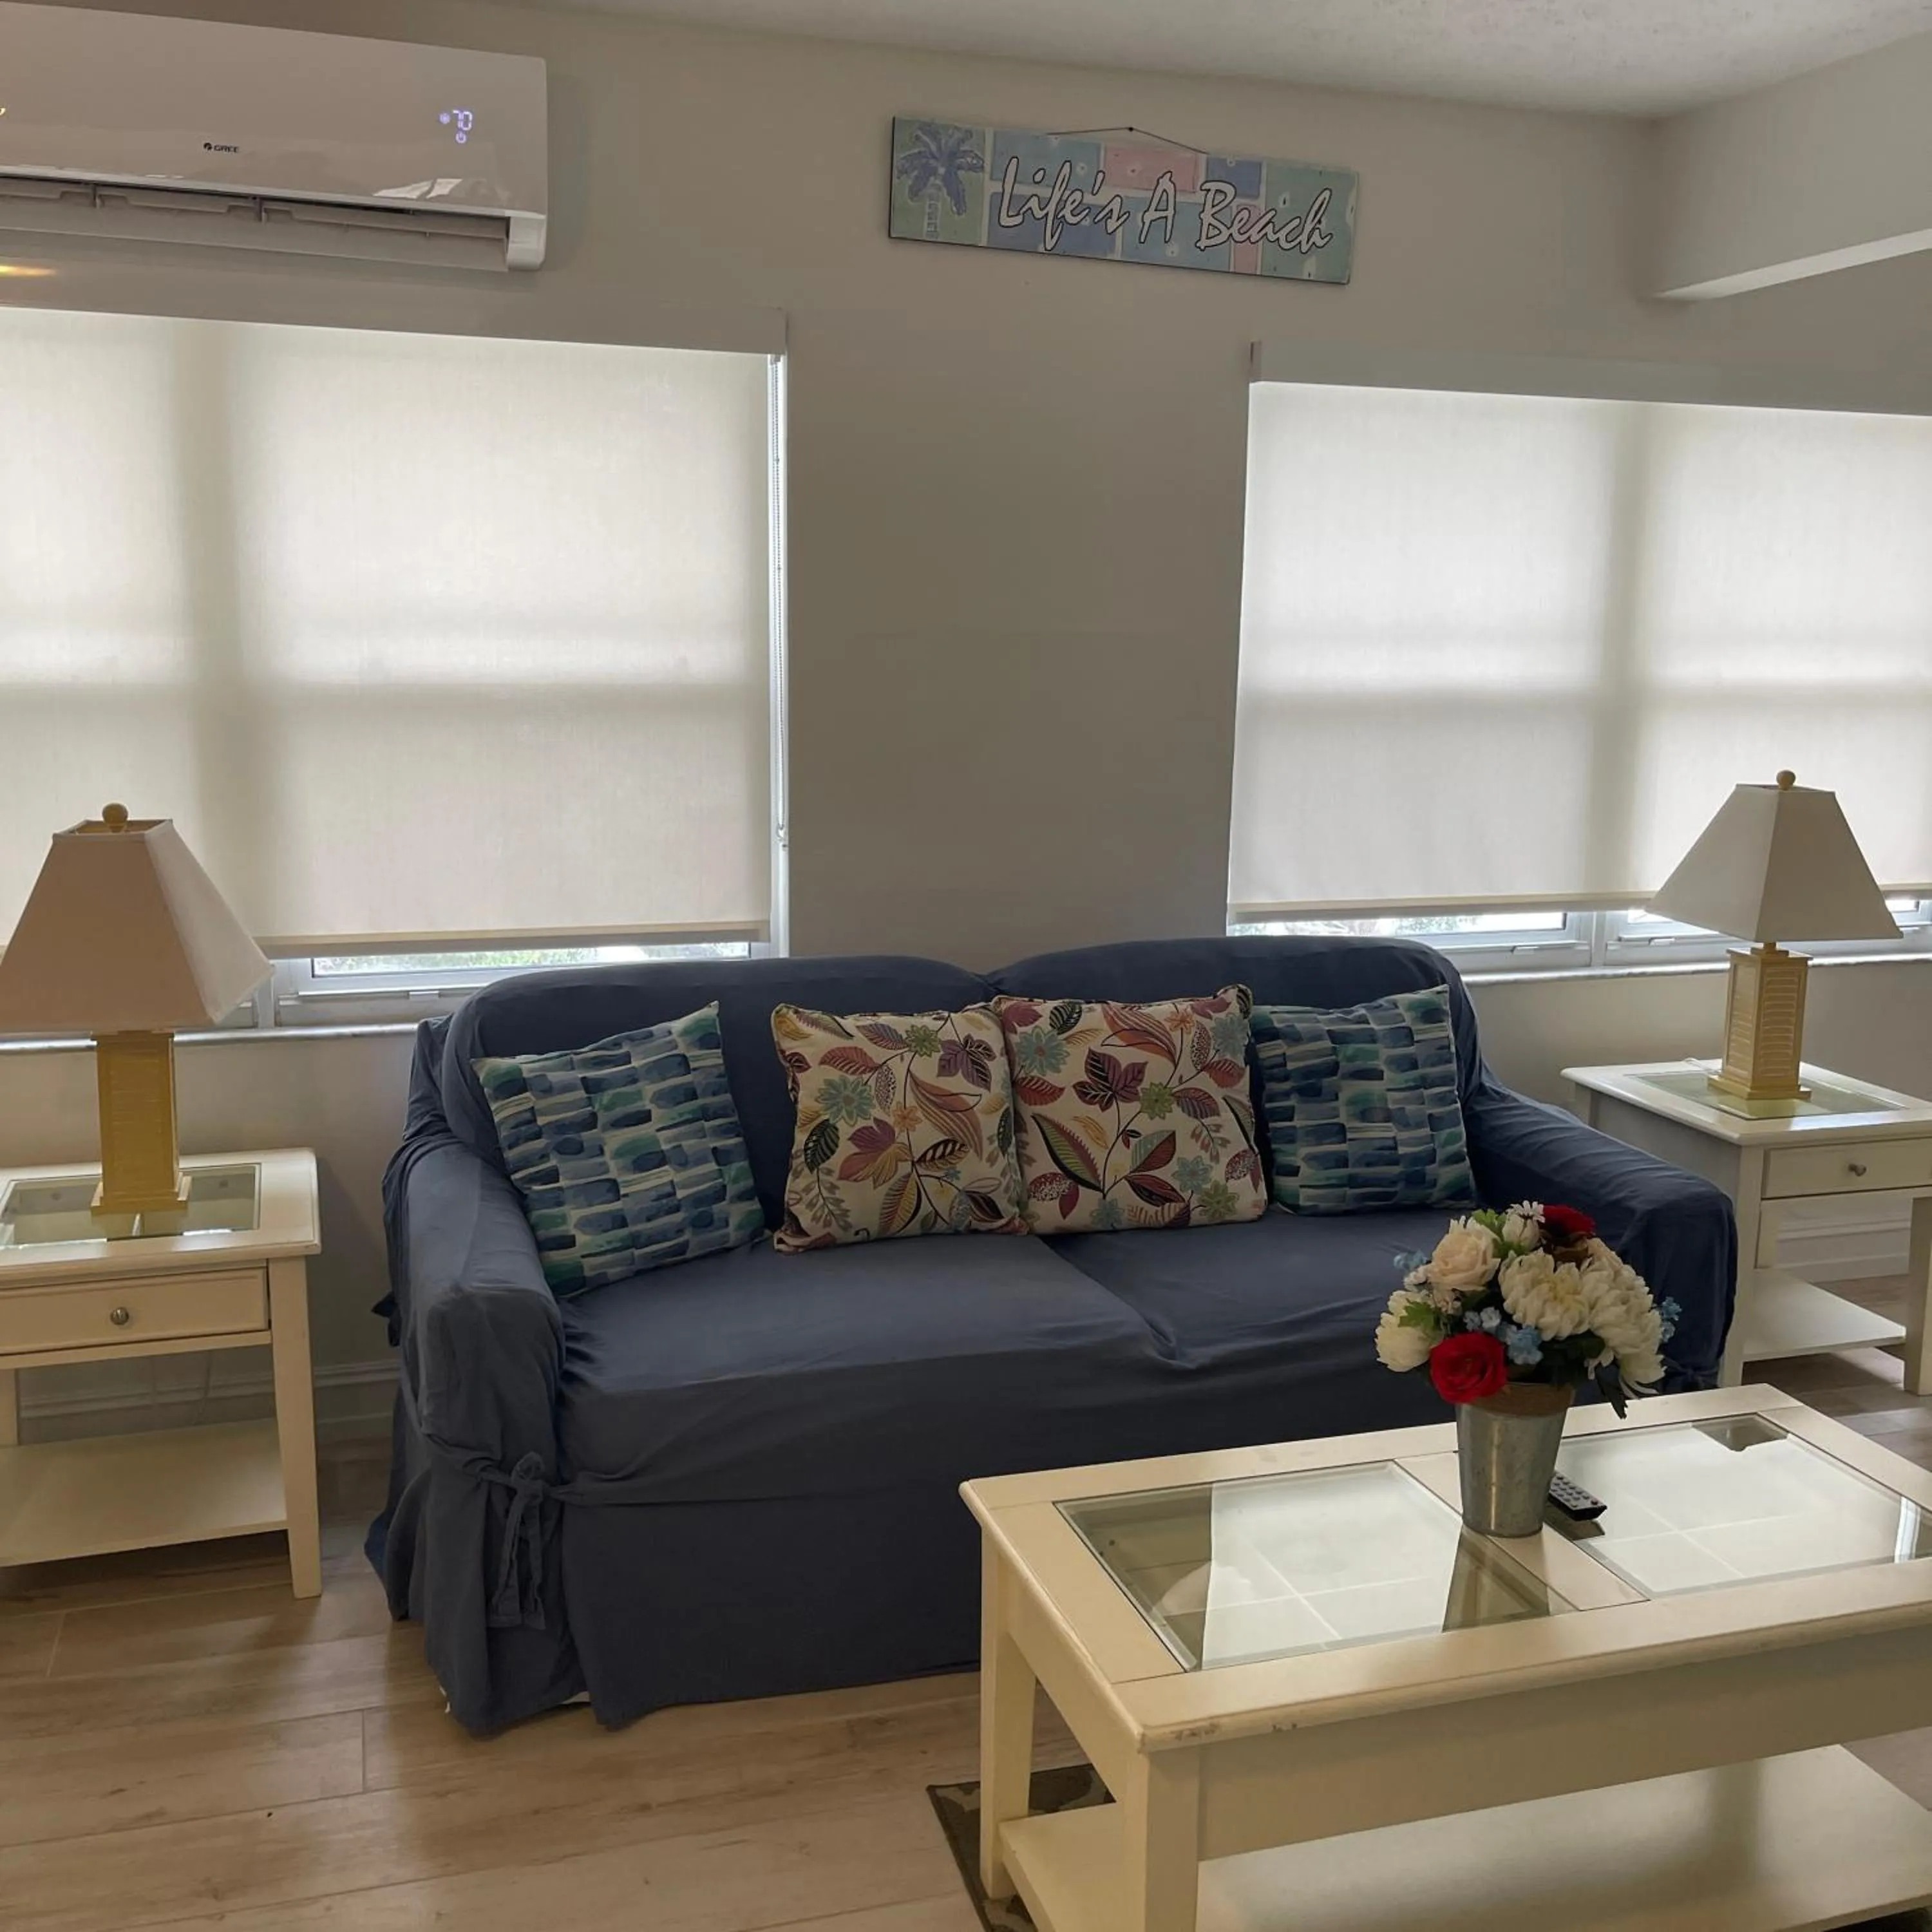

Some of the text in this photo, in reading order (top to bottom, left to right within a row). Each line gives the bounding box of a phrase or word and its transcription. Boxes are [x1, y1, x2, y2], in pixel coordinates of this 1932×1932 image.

[453, 109, 473, 131] 70
[213, 144, 240, 153] GREE
[998, 156, 1334, 253] Life's A Beach
